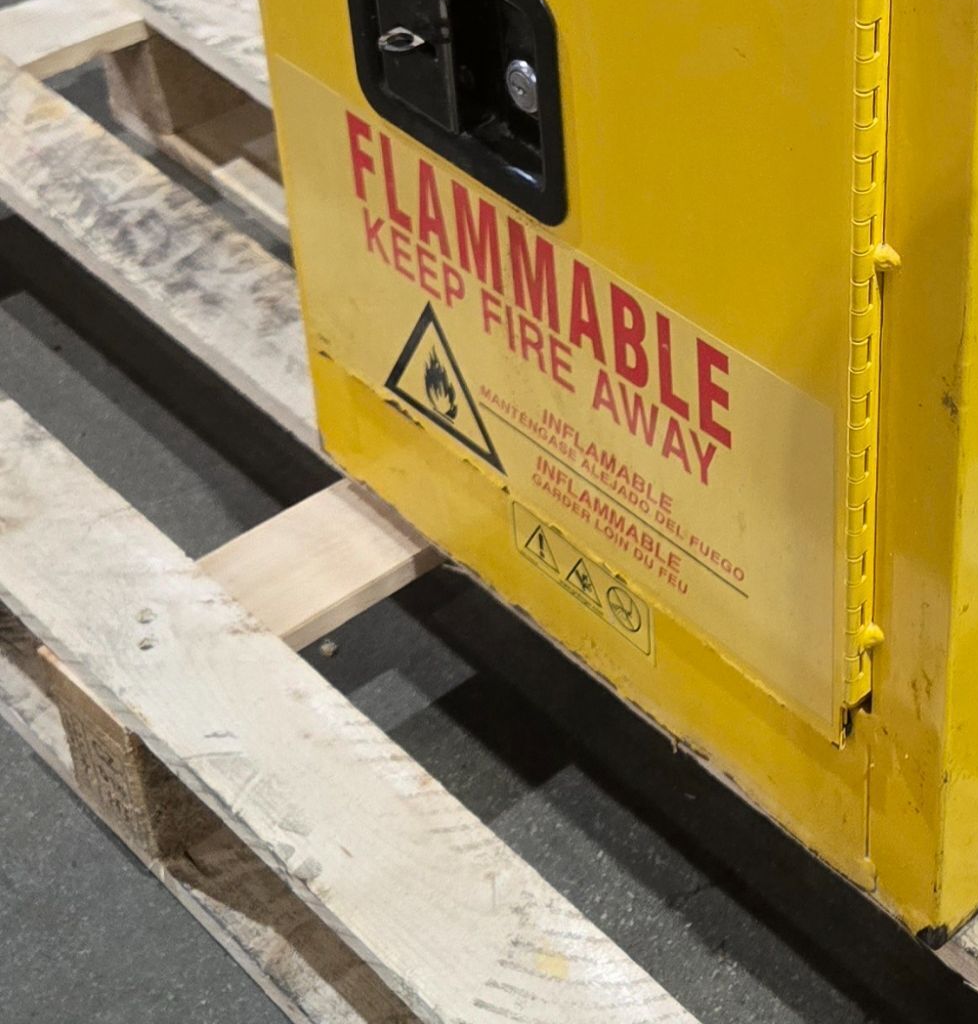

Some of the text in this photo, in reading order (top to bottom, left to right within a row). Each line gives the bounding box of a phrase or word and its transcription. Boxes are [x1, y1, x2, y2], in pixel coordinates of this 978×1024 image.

[346, 110, 732, 449] FLAMMABLE
[363, 207, 717, 486] KEEP FIRE AWAY
[536, 455, 682, 574] INFLAMMABLE
[542, 409, 673, 515] INFLAMABLE
[581, 458, 650, 513] ALEJADO
[655, 510, 684, 540] DEL
[689, 535, 745, 582] FUEGO
[532, 473, 688, 594] GARDER LOIN DU FEU
